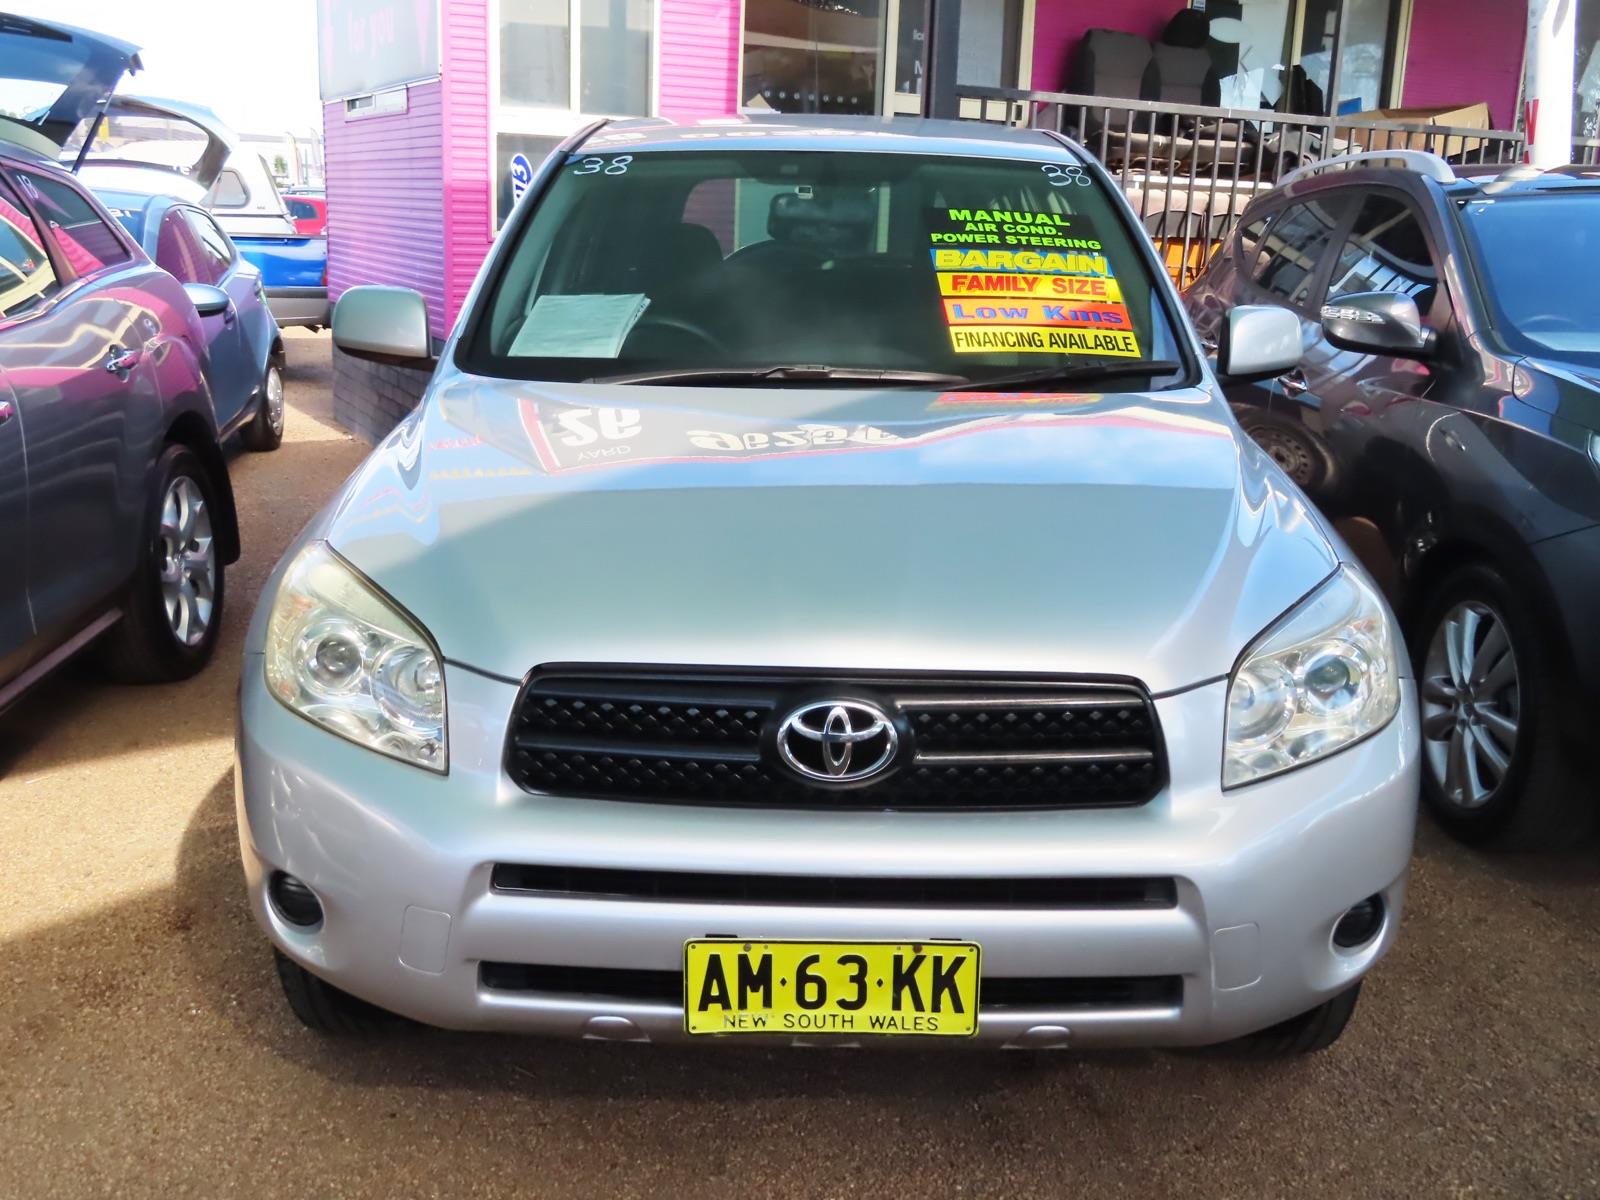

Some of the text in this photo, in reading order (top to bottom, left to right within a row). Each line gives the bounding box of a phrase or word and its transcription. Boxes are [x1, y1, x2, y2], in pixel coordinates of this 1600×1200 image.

[573, 155, 633, 175] 38
[1041, 164, 1092, 186] 38
[949, 209, 1071, 227] MANUAL
[965, 222, 1063, 236] AIR COND.
[931, 233, 1102, 250] POWER STEERING
[935, 249, 1108, 275] BARGAIN
[951, 275, 1107, 297] FAMILY SIZE
[954, 331, 1135, 352] FINANCING AVAILABLE
[723, 1014, 939, 1031] NEW SOUTH WALES
